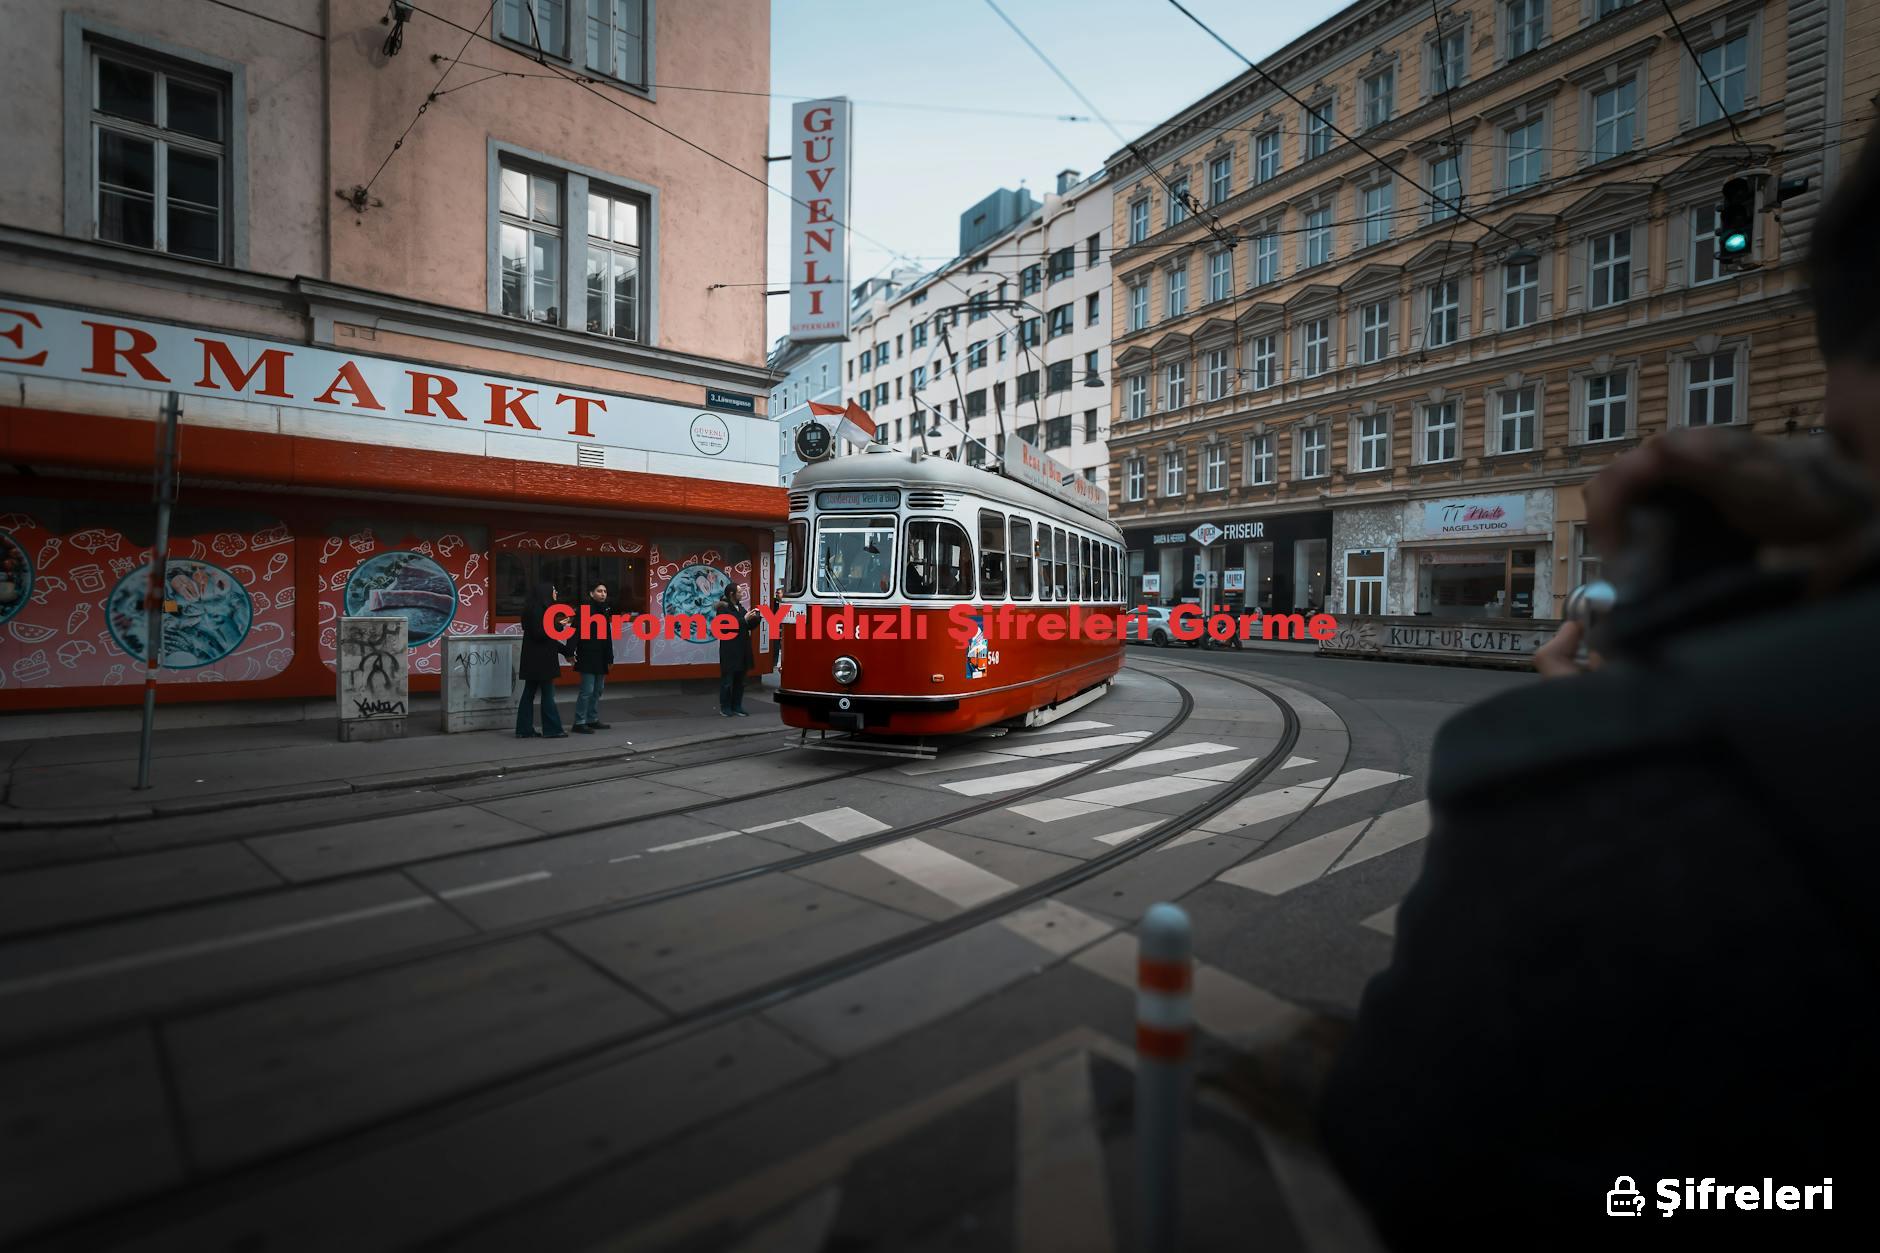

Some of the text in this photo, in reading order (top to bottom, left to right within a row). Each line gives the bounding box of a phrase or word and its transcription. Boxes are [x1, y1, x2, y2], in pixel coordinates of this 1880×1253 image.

[802, 107, 837, 315] GÜVENLI
[1224, 522, 1264, 540] FRISEUR
[1442, 522, 1508, 533] NAGELSTUDIO
[988, 651, 1000, 666] 548
